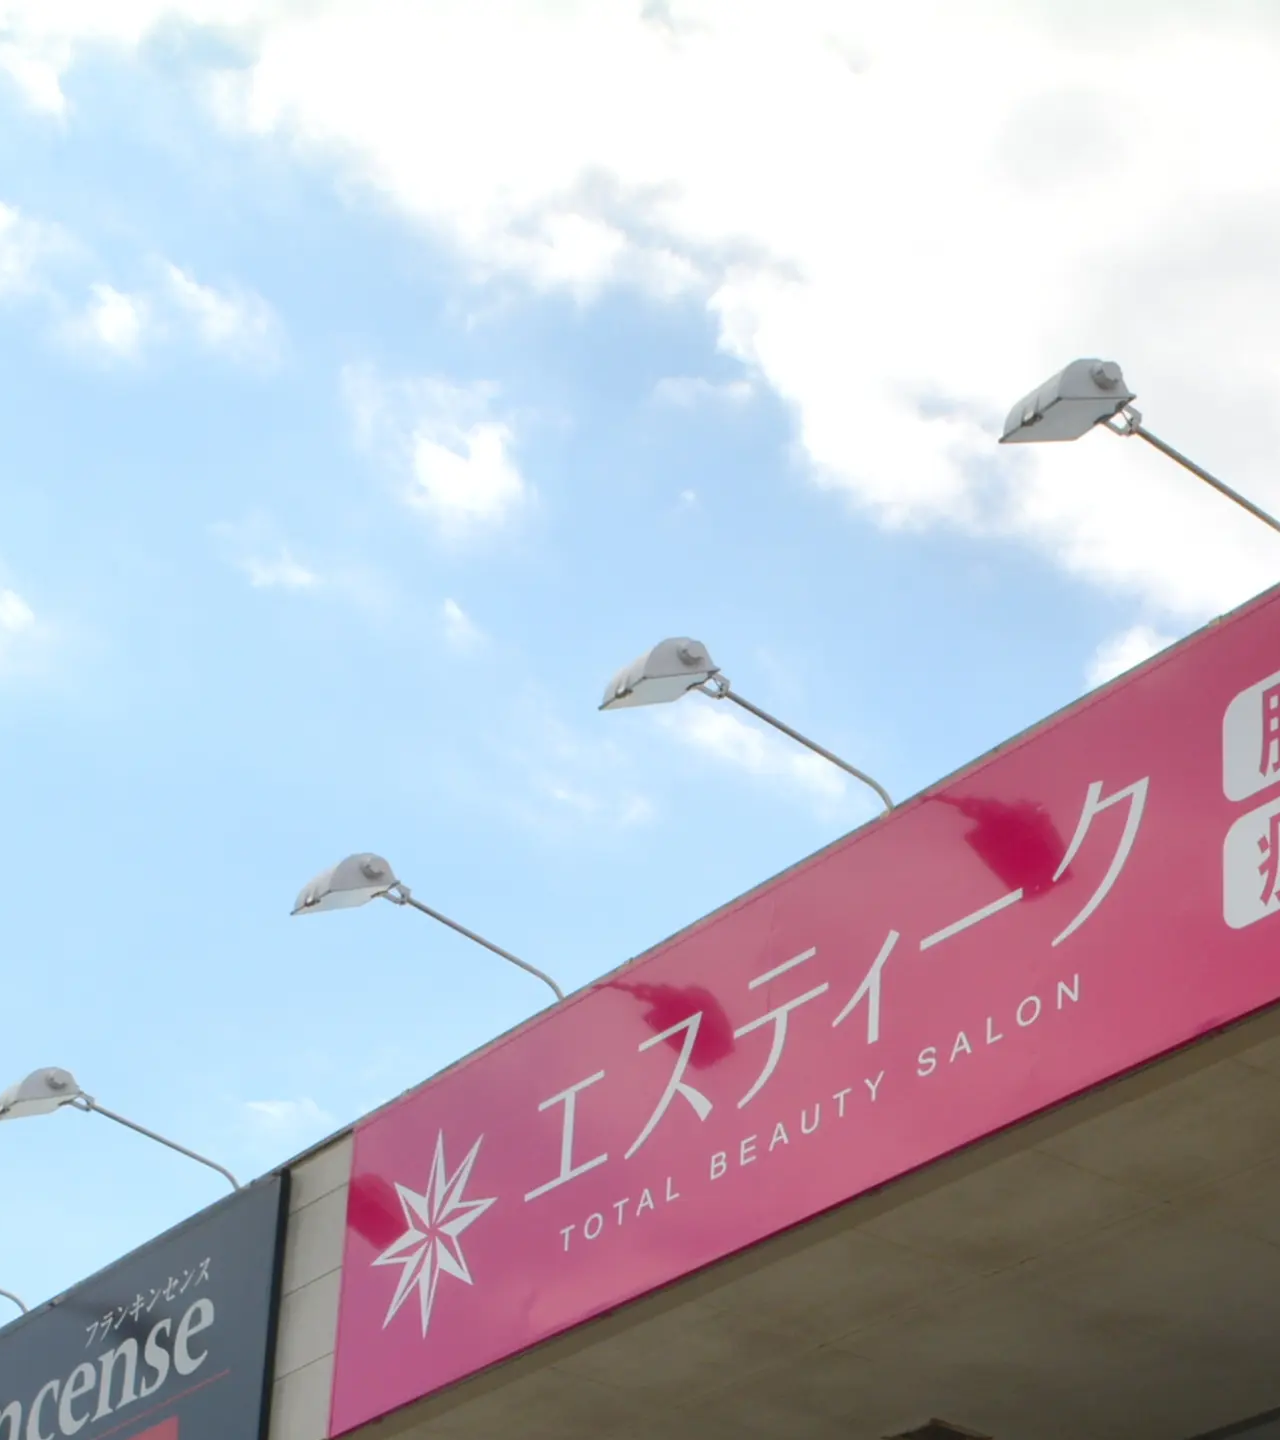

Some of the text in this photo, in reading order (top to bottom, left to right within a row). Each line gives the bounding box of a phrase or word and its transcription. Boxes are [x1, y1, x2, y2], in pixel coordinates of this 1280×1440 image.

[524, 775, 1150, 1203] エスティーク
[558, 972, 1083, 1254] TOTAL BEAUTY SALON
[83, 1256, 212, 1350] フランキンセンス
